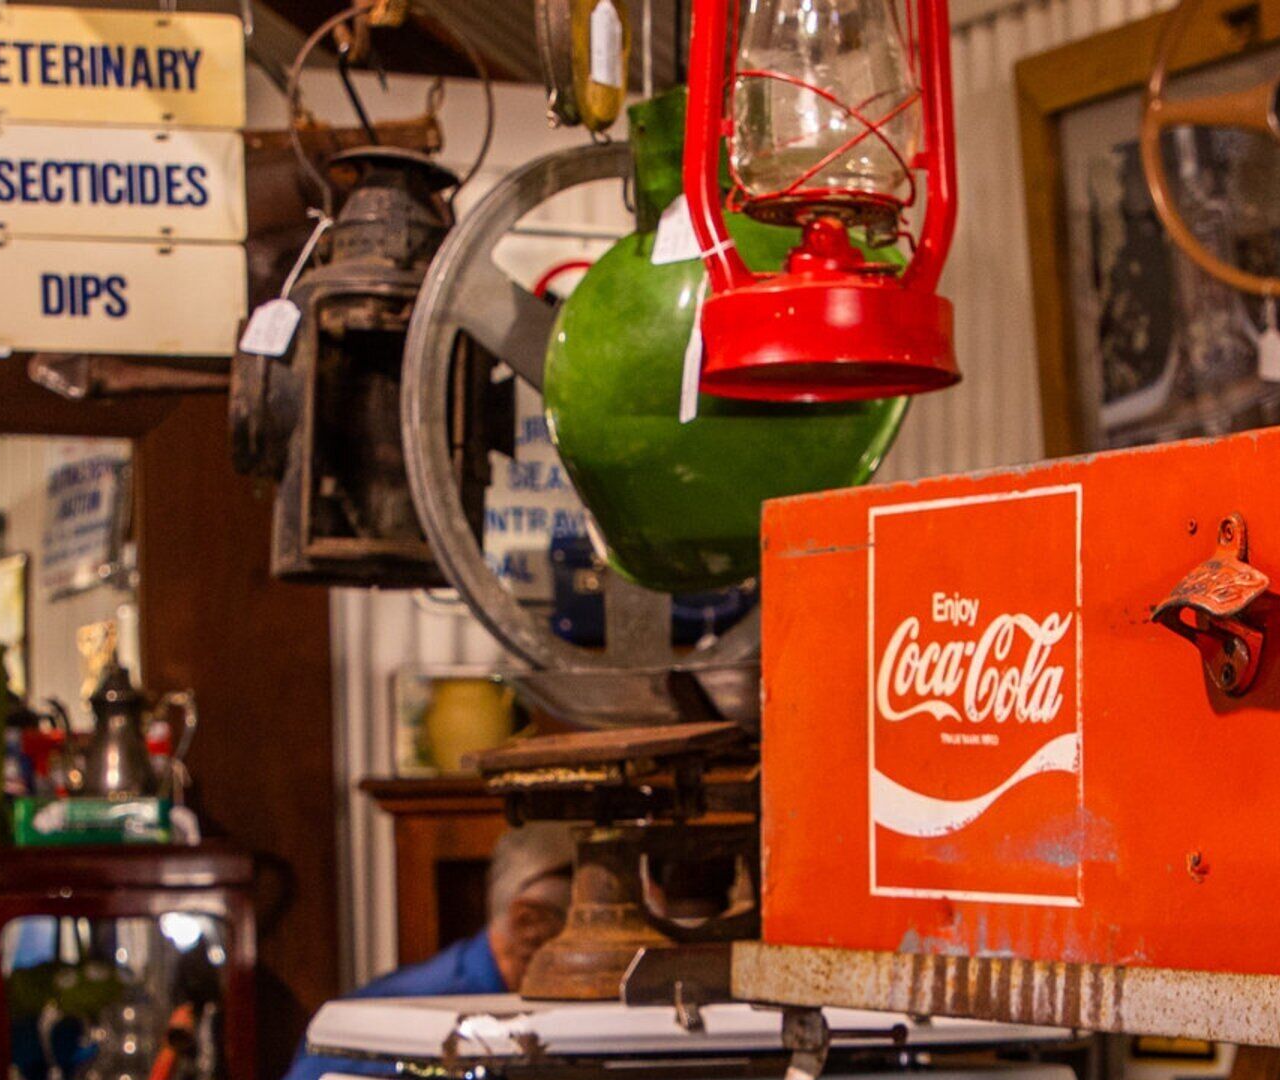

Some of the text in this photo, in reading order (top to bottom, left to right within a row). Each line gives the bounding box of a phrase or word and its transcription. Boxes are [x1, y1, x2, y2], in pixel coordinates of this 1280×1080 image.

[40, 273, 129, 318] DIPS
[932, 592, 979, 627] Enjoy
[877, 611, 1073, 723] Coca-Cola
